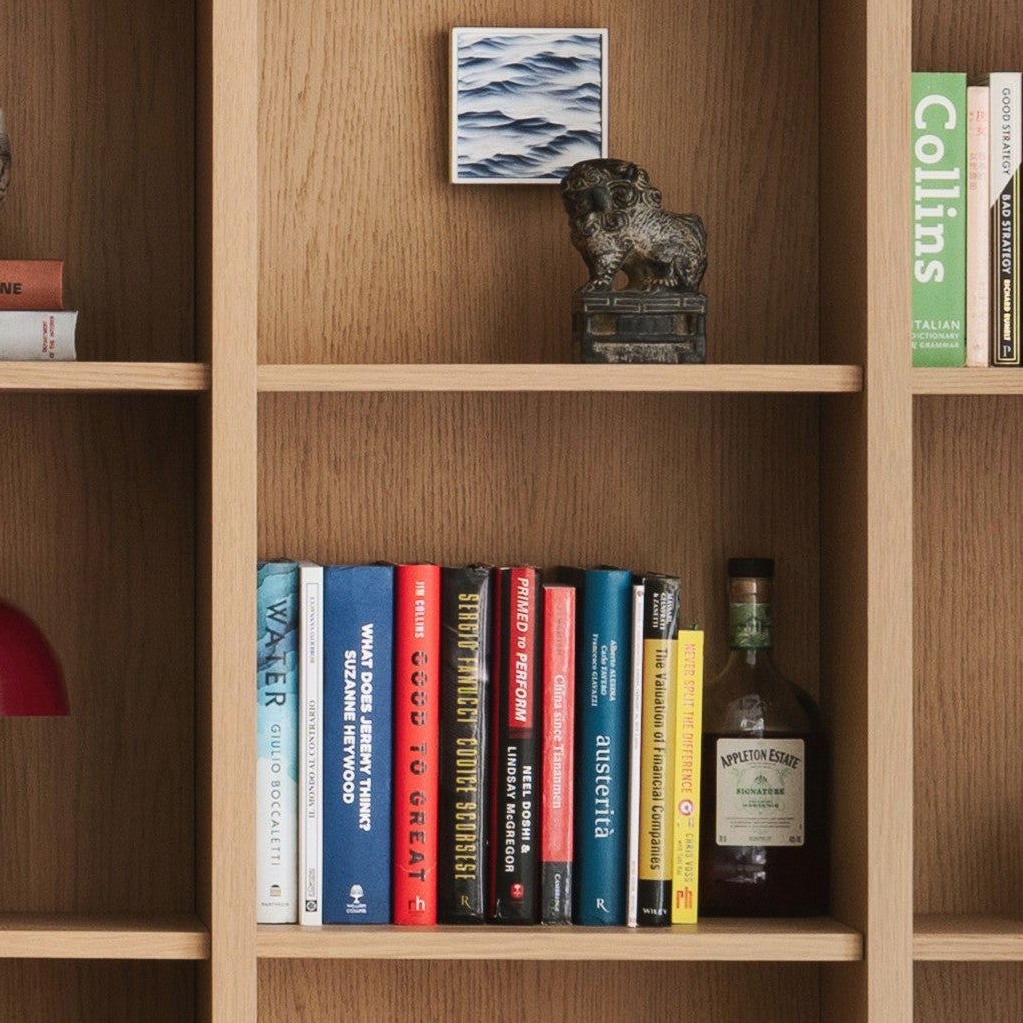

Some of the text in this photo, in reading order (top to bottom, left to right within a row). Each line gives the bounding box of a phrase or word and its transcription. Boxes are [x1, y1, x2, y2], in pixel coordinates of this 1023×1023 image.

[1001, 87, 1011, 127] GOOD
[1001, 128, 1011, 177] STRATEGY
[913, 94, 961, 285] Collins
[1001, 193, 1011, 217] BAD
[1001, 218, 1011, 275] STRATEGY
[414, 580, 426, 639] JIM COLLINS
[515, 576, 530, 633] PRIMED
[514, 651, 529, 723] PERFORM
[683, 643, 697, 677] NEVER
[681, 711, 695, 731] THE
[682, 679, 696, 707] SPLIT
[265, 599, 287, 866] WATER GIULIO BOCCALETTI
[308, 700, 316, 756] CONTRARIO
[342, 649, 357, 805] SUZANNE HEYWOOD
[358, 623, 374, 832] WHAT DOES JEREMY THINK?
[454, 592, 480, 881] SERGIO FANUCCI CODICE SCORSESE
[551, 674, 565, 810] China since Tiananmen
[408, 650, 429, 883] GOOD TO GREAT
[593, 734, 616, 839] austerità
[646, 648, 669, 871] The Valuation of Financial Companies
[680, 732, 695, 794] DIFFERENCE
[720, 748, 802, 770] APPLETON ESTATE
[308, 772, 316, 808] MONDO
[503, 745, 518, 873] LINDSAY McGREGOR
[519, 765, 533, 854] NEEL DOSHI &
[736, 788, 786, 796] SIGNATURE
[683, 832, 695, 859] CHRIS
[683, 860, 694, 883] VOSS
